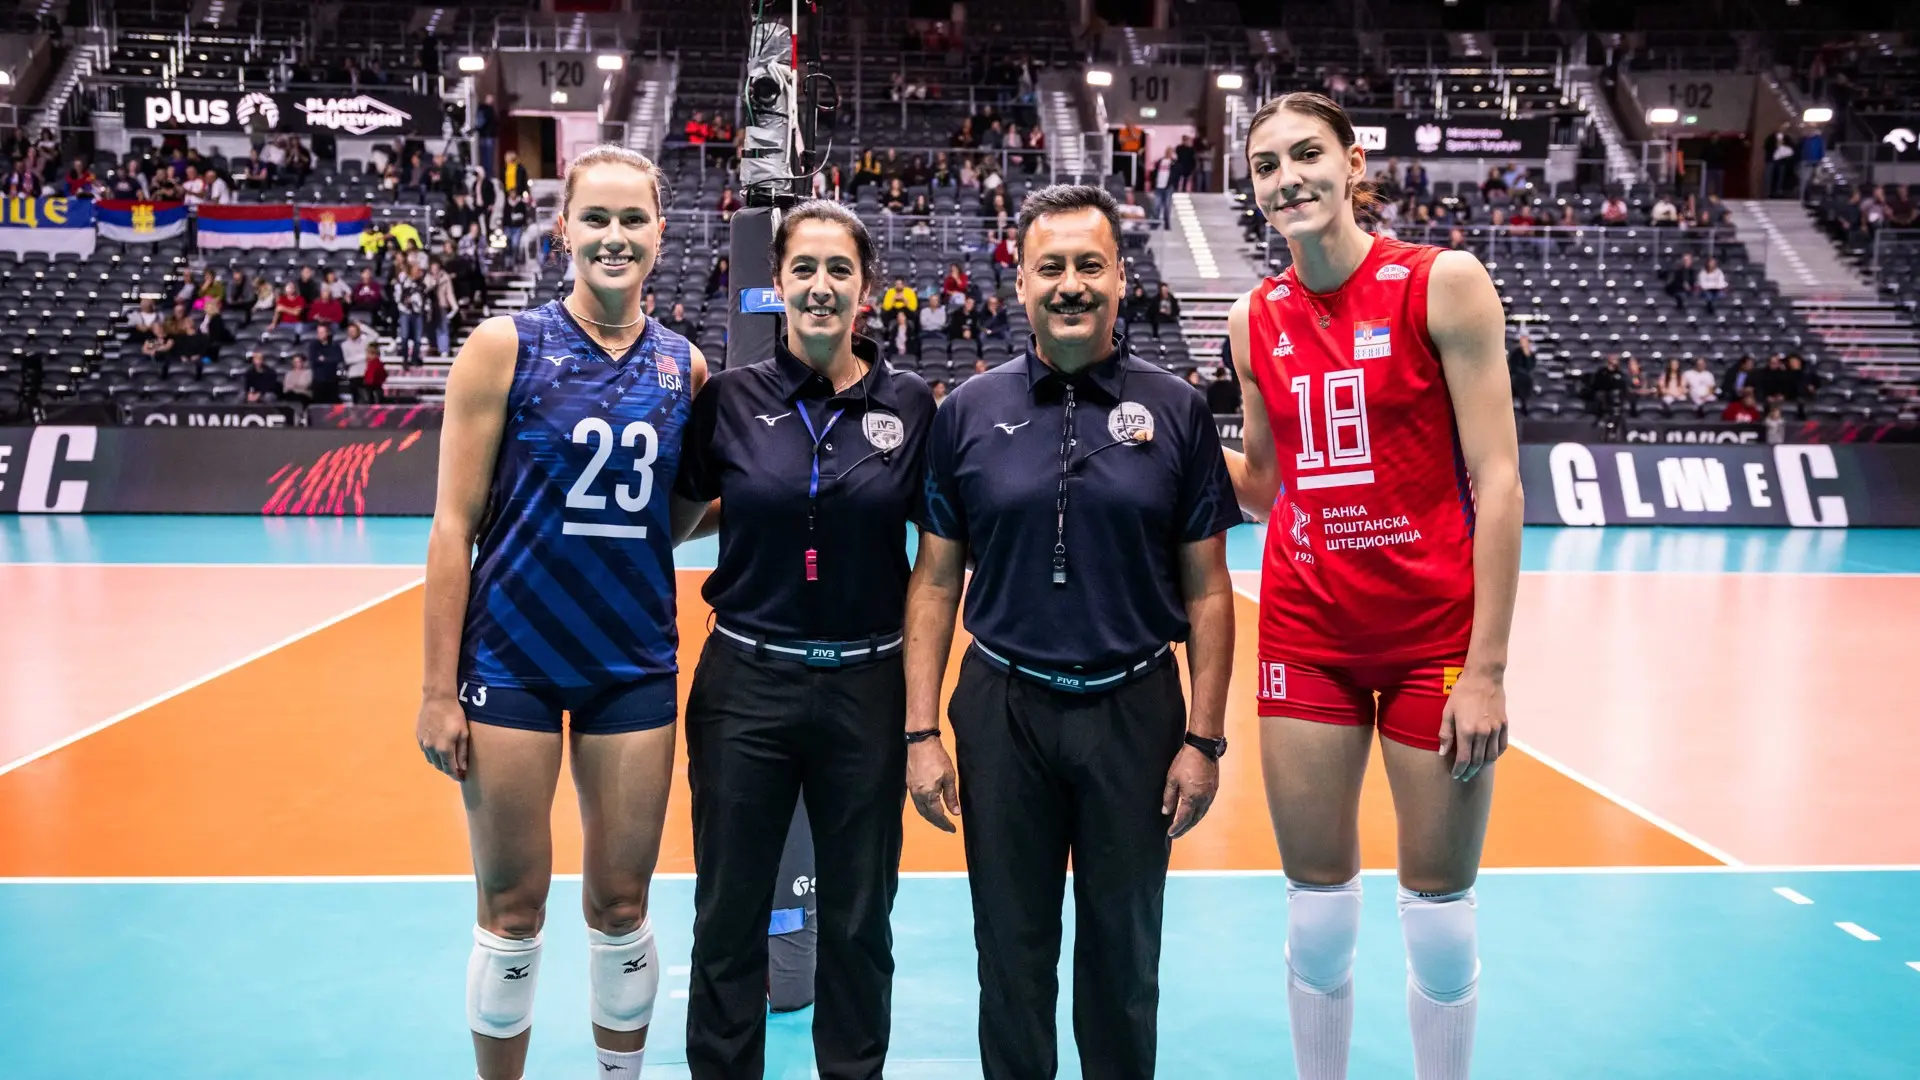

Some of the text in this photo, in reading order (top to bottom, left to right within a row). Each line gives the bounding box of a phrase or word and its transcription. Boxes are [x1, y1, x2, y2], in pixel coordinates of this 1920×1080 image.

[539, 61, 584, 87] 1-20
[1130, 76, 1169, 102] 1-01
[1668, 83, 1714, 109] 1-02
[145, 90, 230, 129] plus
[657, 372, 682, 392] USA
[1291, 368, 1372, 470] 18
[565, 417, 659, 513] 23
[1322, 505, 1368, 519] БАНКА
[1324, 515, 1410, 535] ПОШТАНСКА
[1326, 530, 1422, 551] ШТЕДИОНИЦА
[812, 648, 835, 658] FIVB
[1057, 676, 1079, 686] FIVB
[1257, 662, 1286, 699] 18
